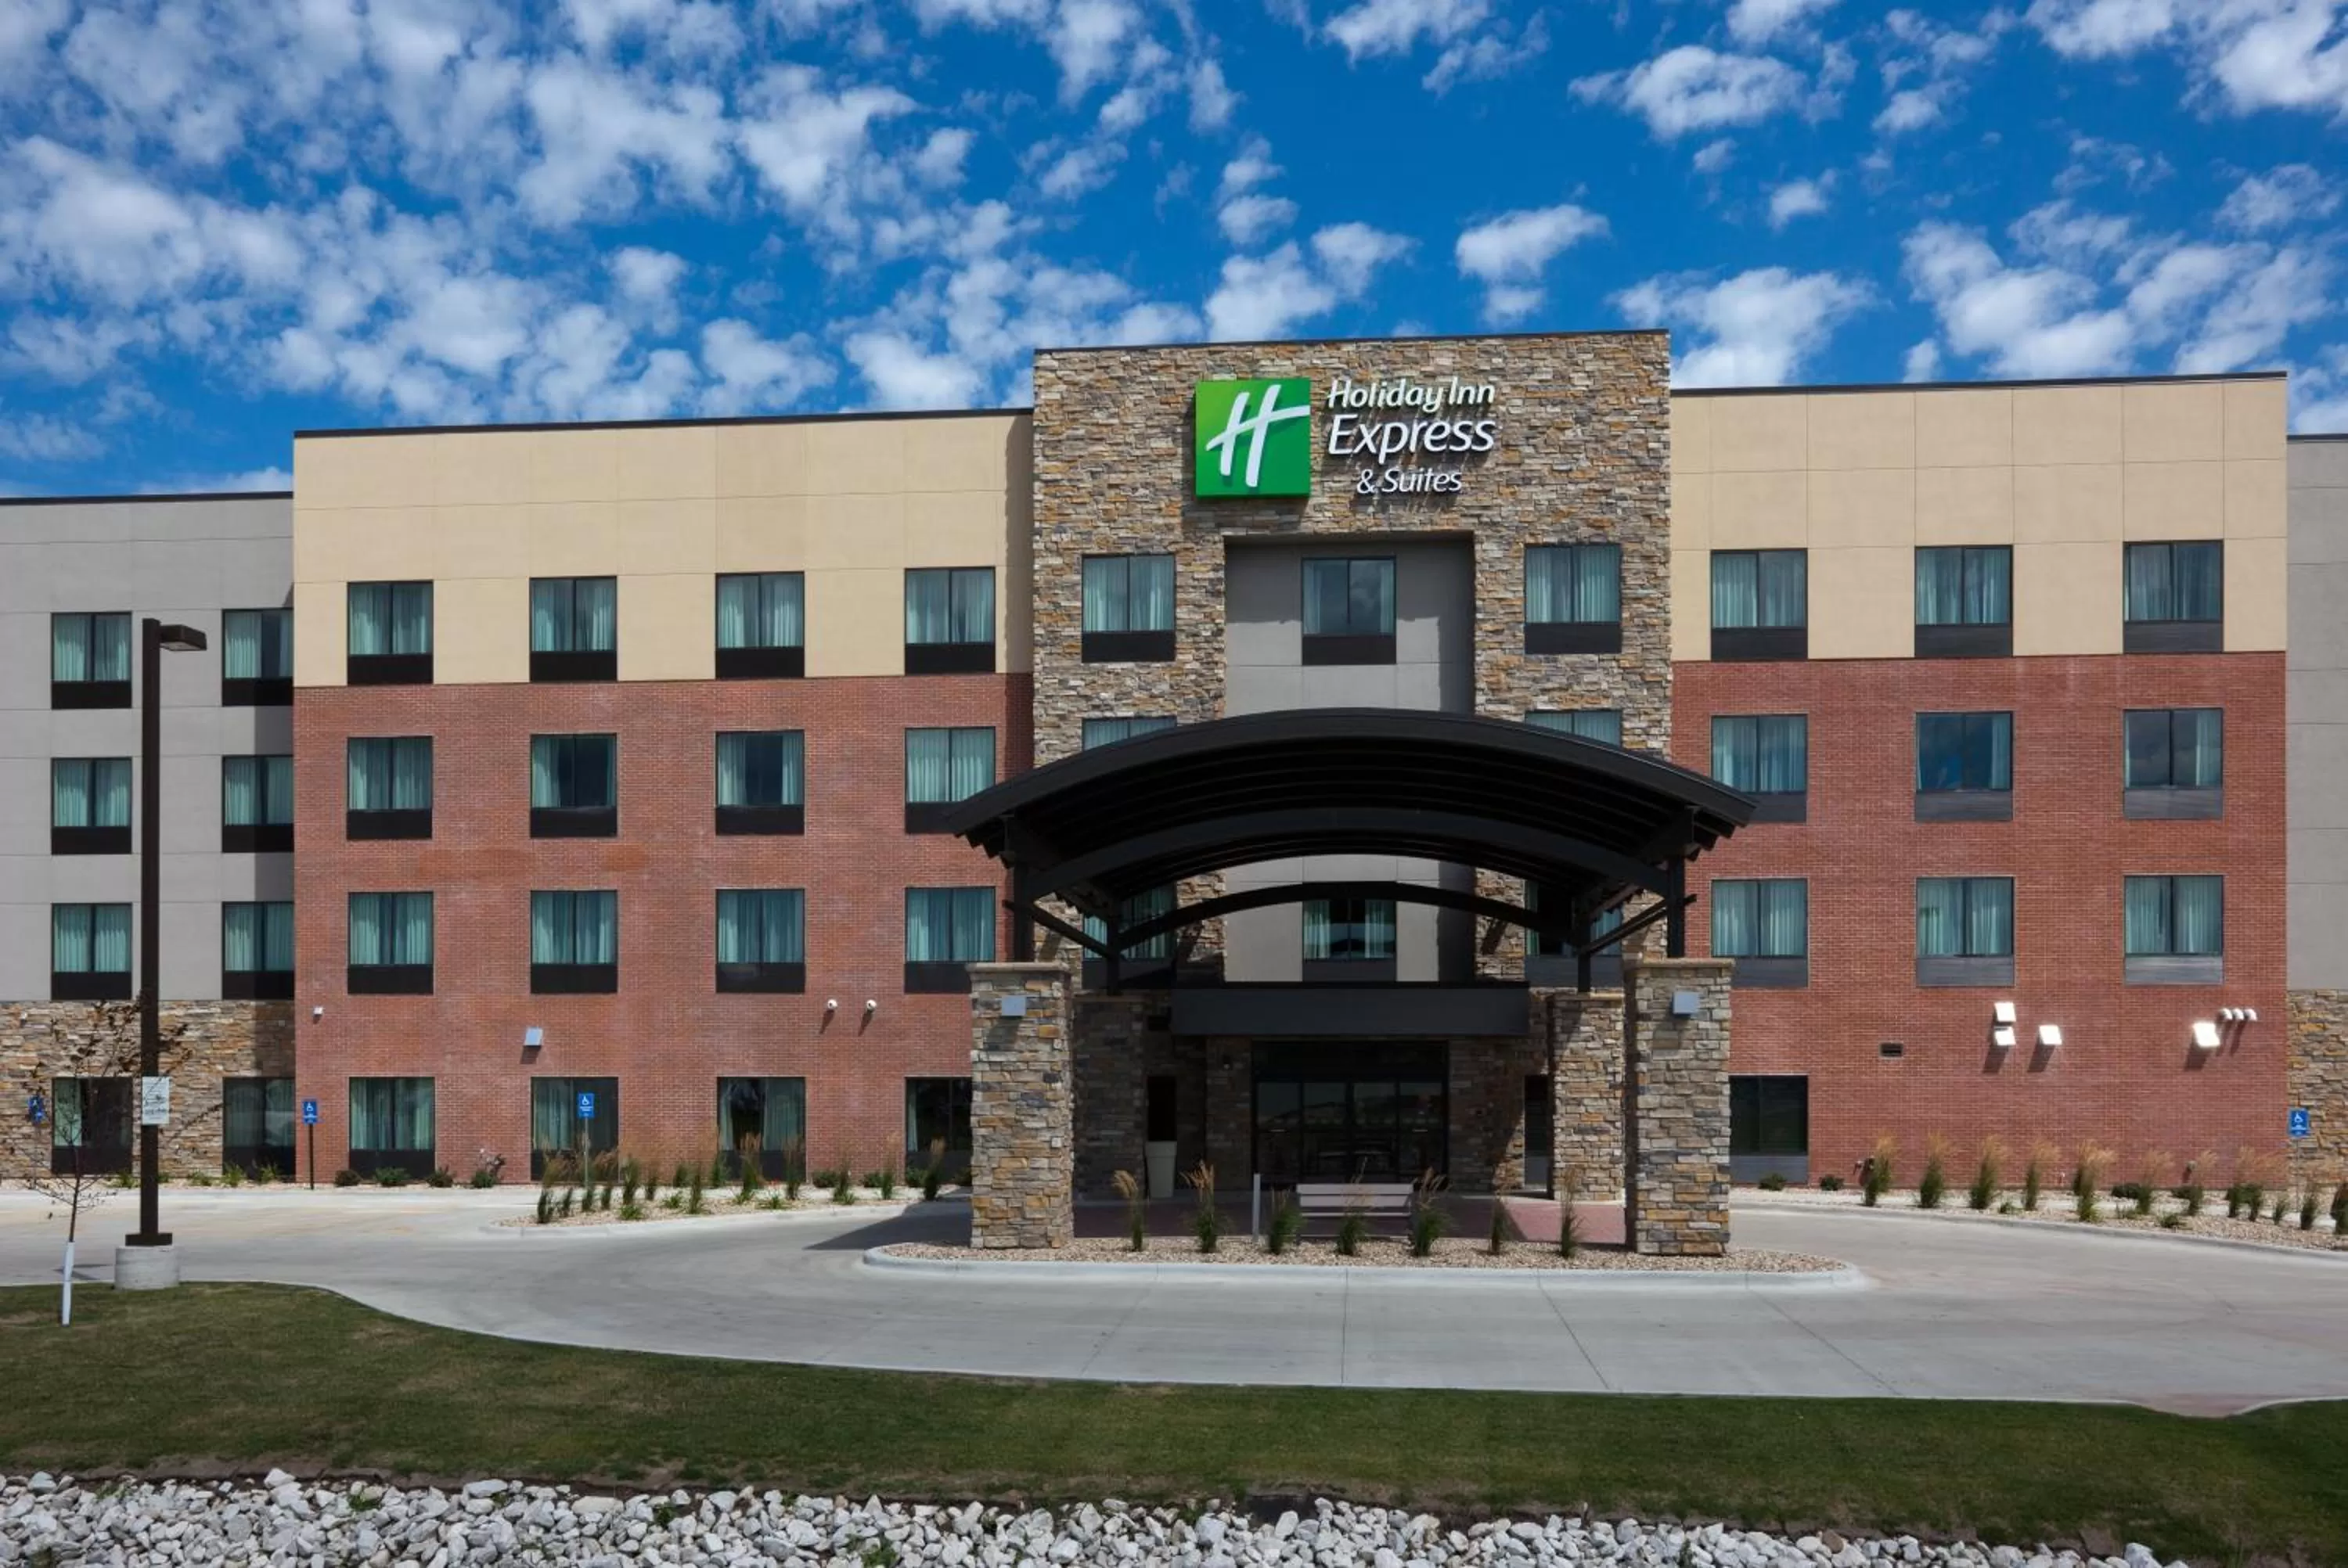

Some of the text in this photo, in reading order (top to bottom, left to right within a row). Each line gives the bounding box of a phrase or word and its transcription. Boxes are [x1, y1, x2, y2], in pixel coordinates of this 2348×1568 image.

[1327, 376, 1495, 413] Holiday Inn
[1328, 413, 1496, 465] Express
[1356, 467, 1462, 494] & Suites
